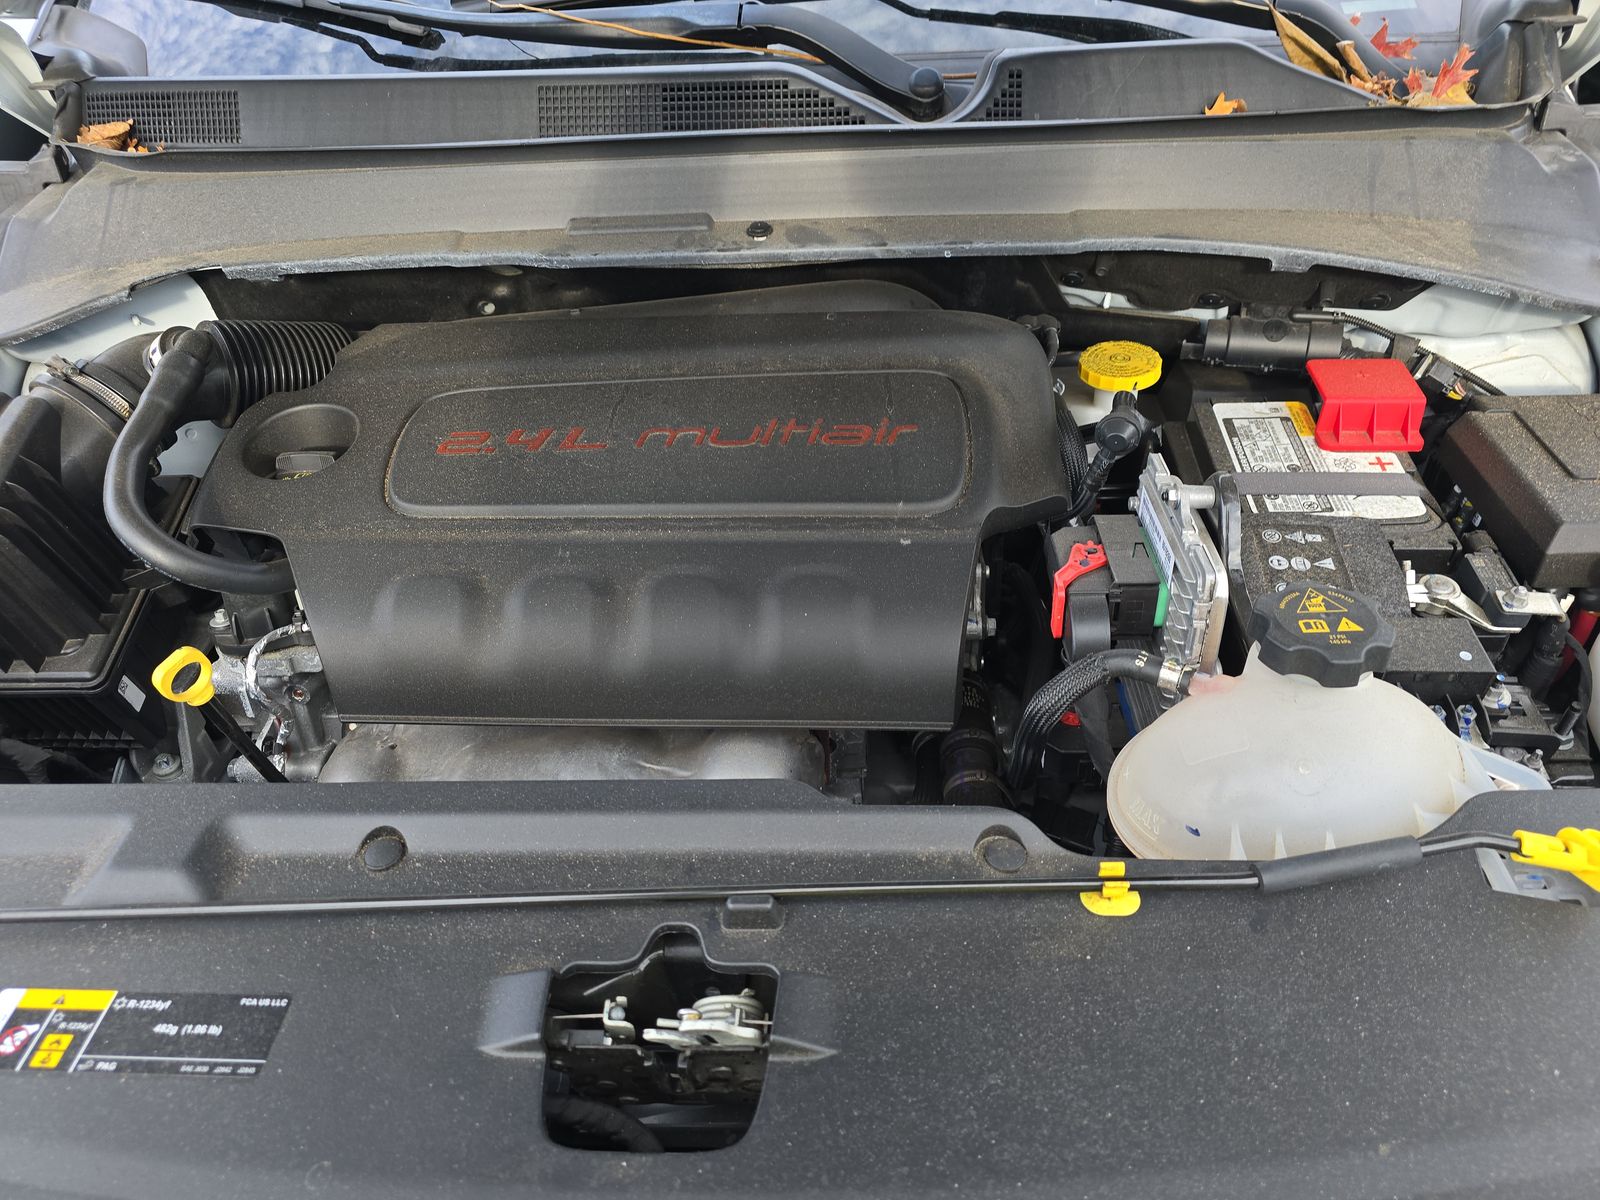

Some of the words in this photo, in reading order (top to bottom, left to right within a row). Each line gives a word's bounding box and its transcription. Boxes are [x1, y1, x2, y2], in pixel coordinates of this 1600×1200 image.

[436, 426, 608, 455] 2.4L
[634, 417, 919, 448] multiair
[271, 998, 289, 1007] LLC
[95, 1061, 118, 1071] PAG
